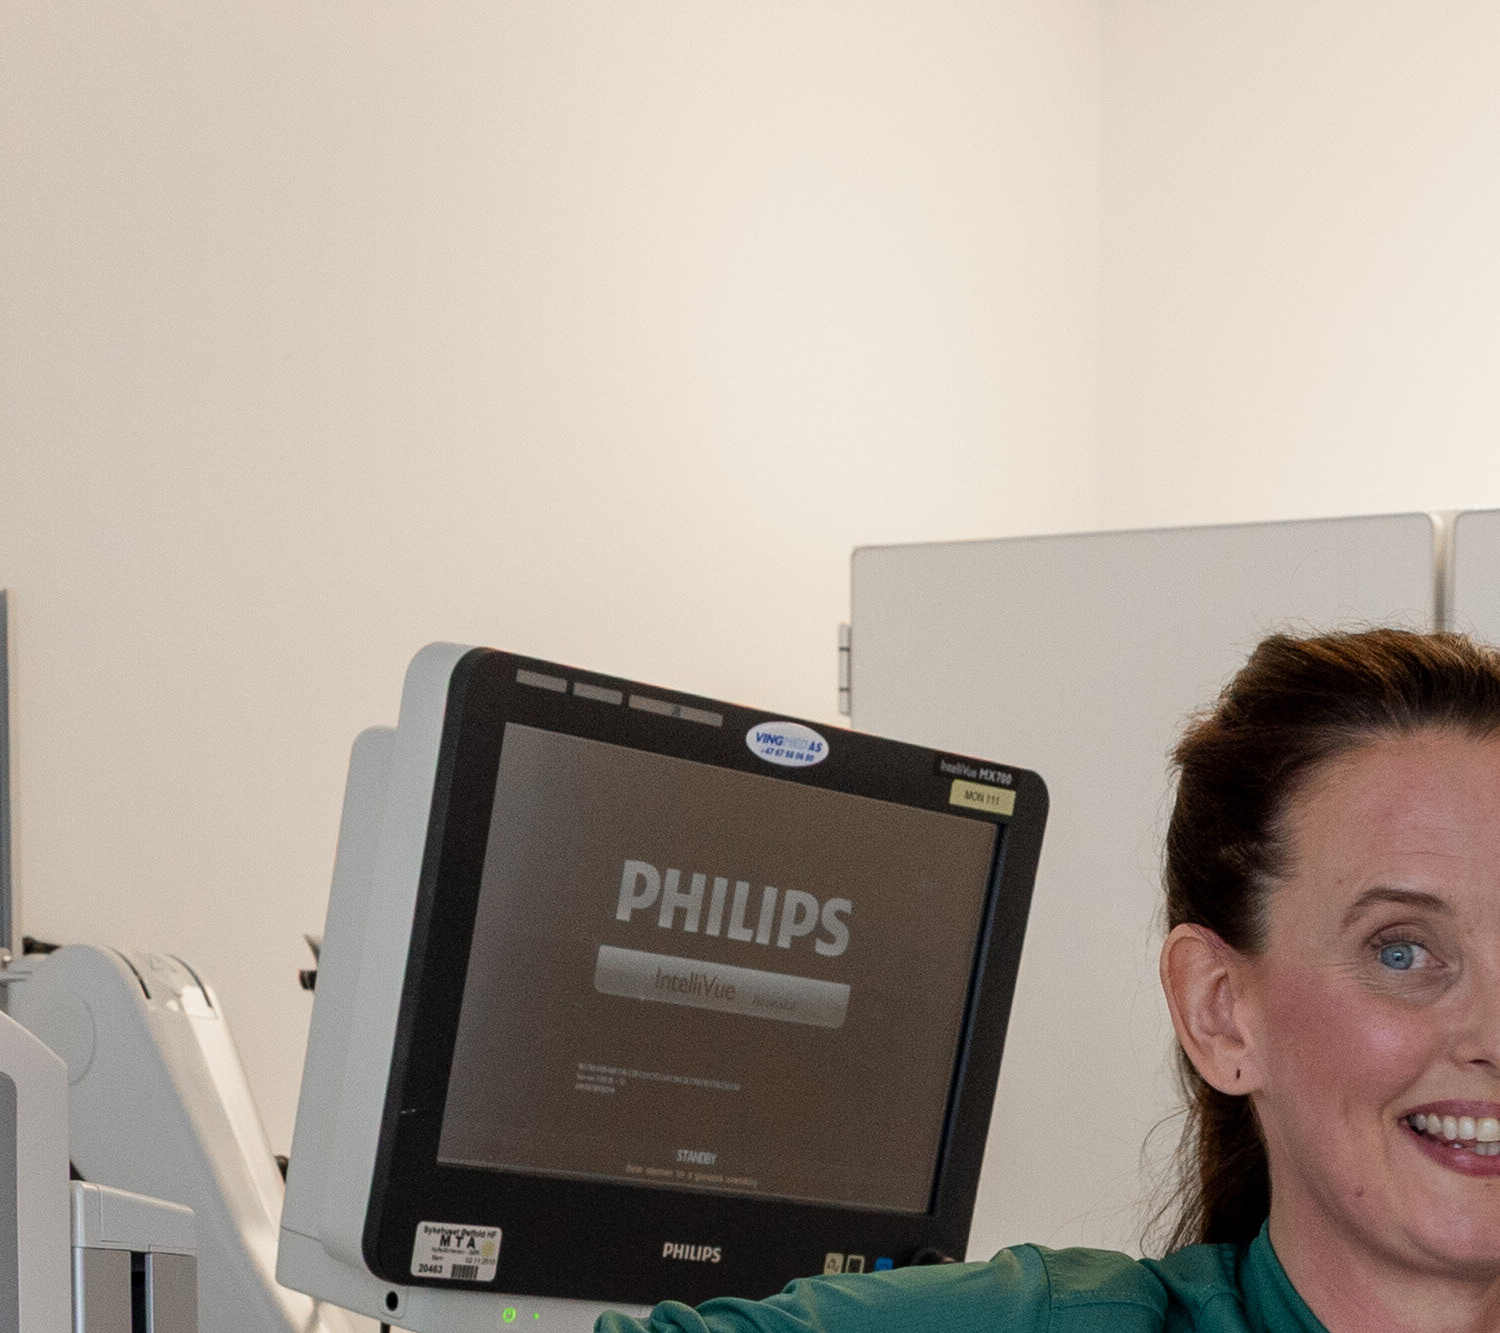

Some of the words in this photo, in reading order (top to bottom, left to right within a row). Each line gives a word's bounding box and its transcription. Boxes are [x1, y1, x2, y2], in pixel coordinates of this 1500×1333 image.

[979, 768, 1012, 784] MX700
[964, 790, 984, 802] MON
[616, 860, 853, 957] PHILIPS
[655, 968, 736, 1001] IntelliVue
[676, 1148, 718, 1165] STANDBY
[662, 1242, 722, 1263] PHILIPS
